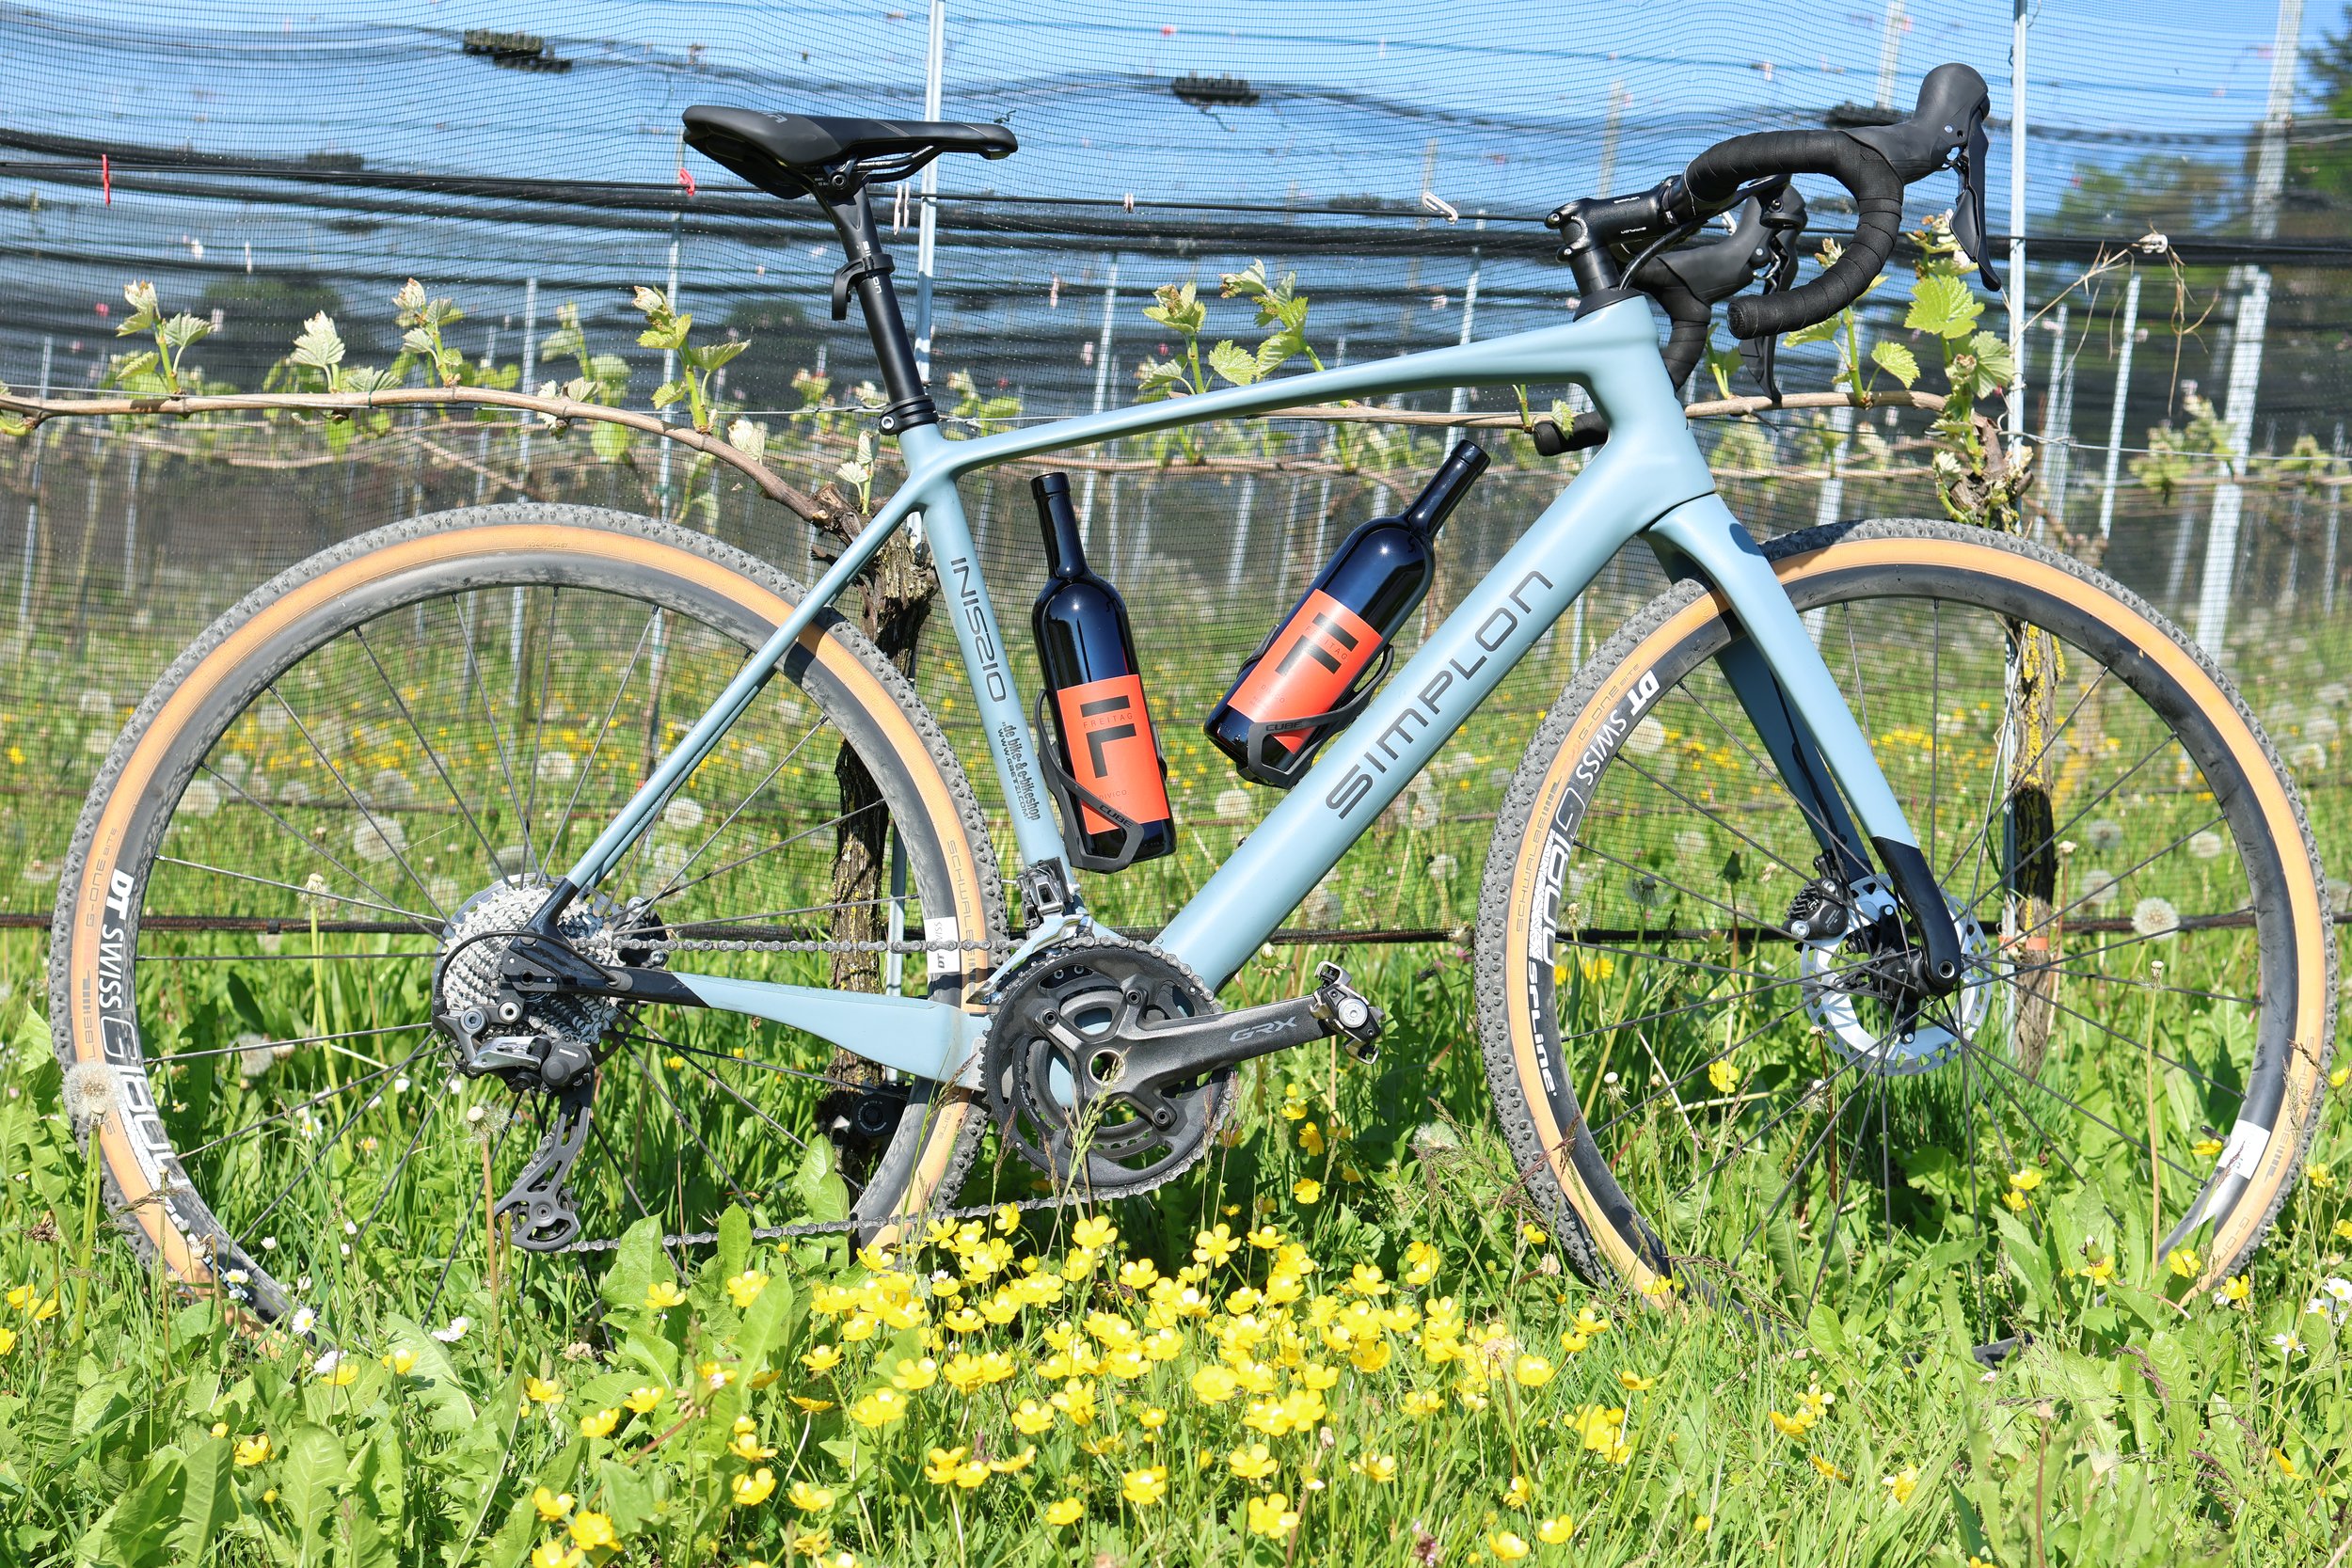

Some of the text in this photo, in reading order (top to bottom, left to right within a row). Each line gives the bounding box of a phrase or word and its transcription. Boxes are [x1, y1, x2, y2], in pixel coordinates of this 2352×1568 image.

[862, 240, 882, 294] SION
[1084, 712, 1134, 729] FREITAG
[1326, 570, 1554, 820] SIMPLON
[1264, 721, 1304, 732] CUBE
[1576, 670, 1660, 786] DT SWISS
[1015, 762, 1028, 772] &
[1099, 804, 1134, 829] CUBE
[86, 858, 106, 927] G-ONE
[1516, 816, 1546, 932] SCHWALBE
[99, 868, 135, 1009] DT SWISS
[933, 921, 946, 969] DT WISS
[1229, 1016, 1297, 1042] GRX
